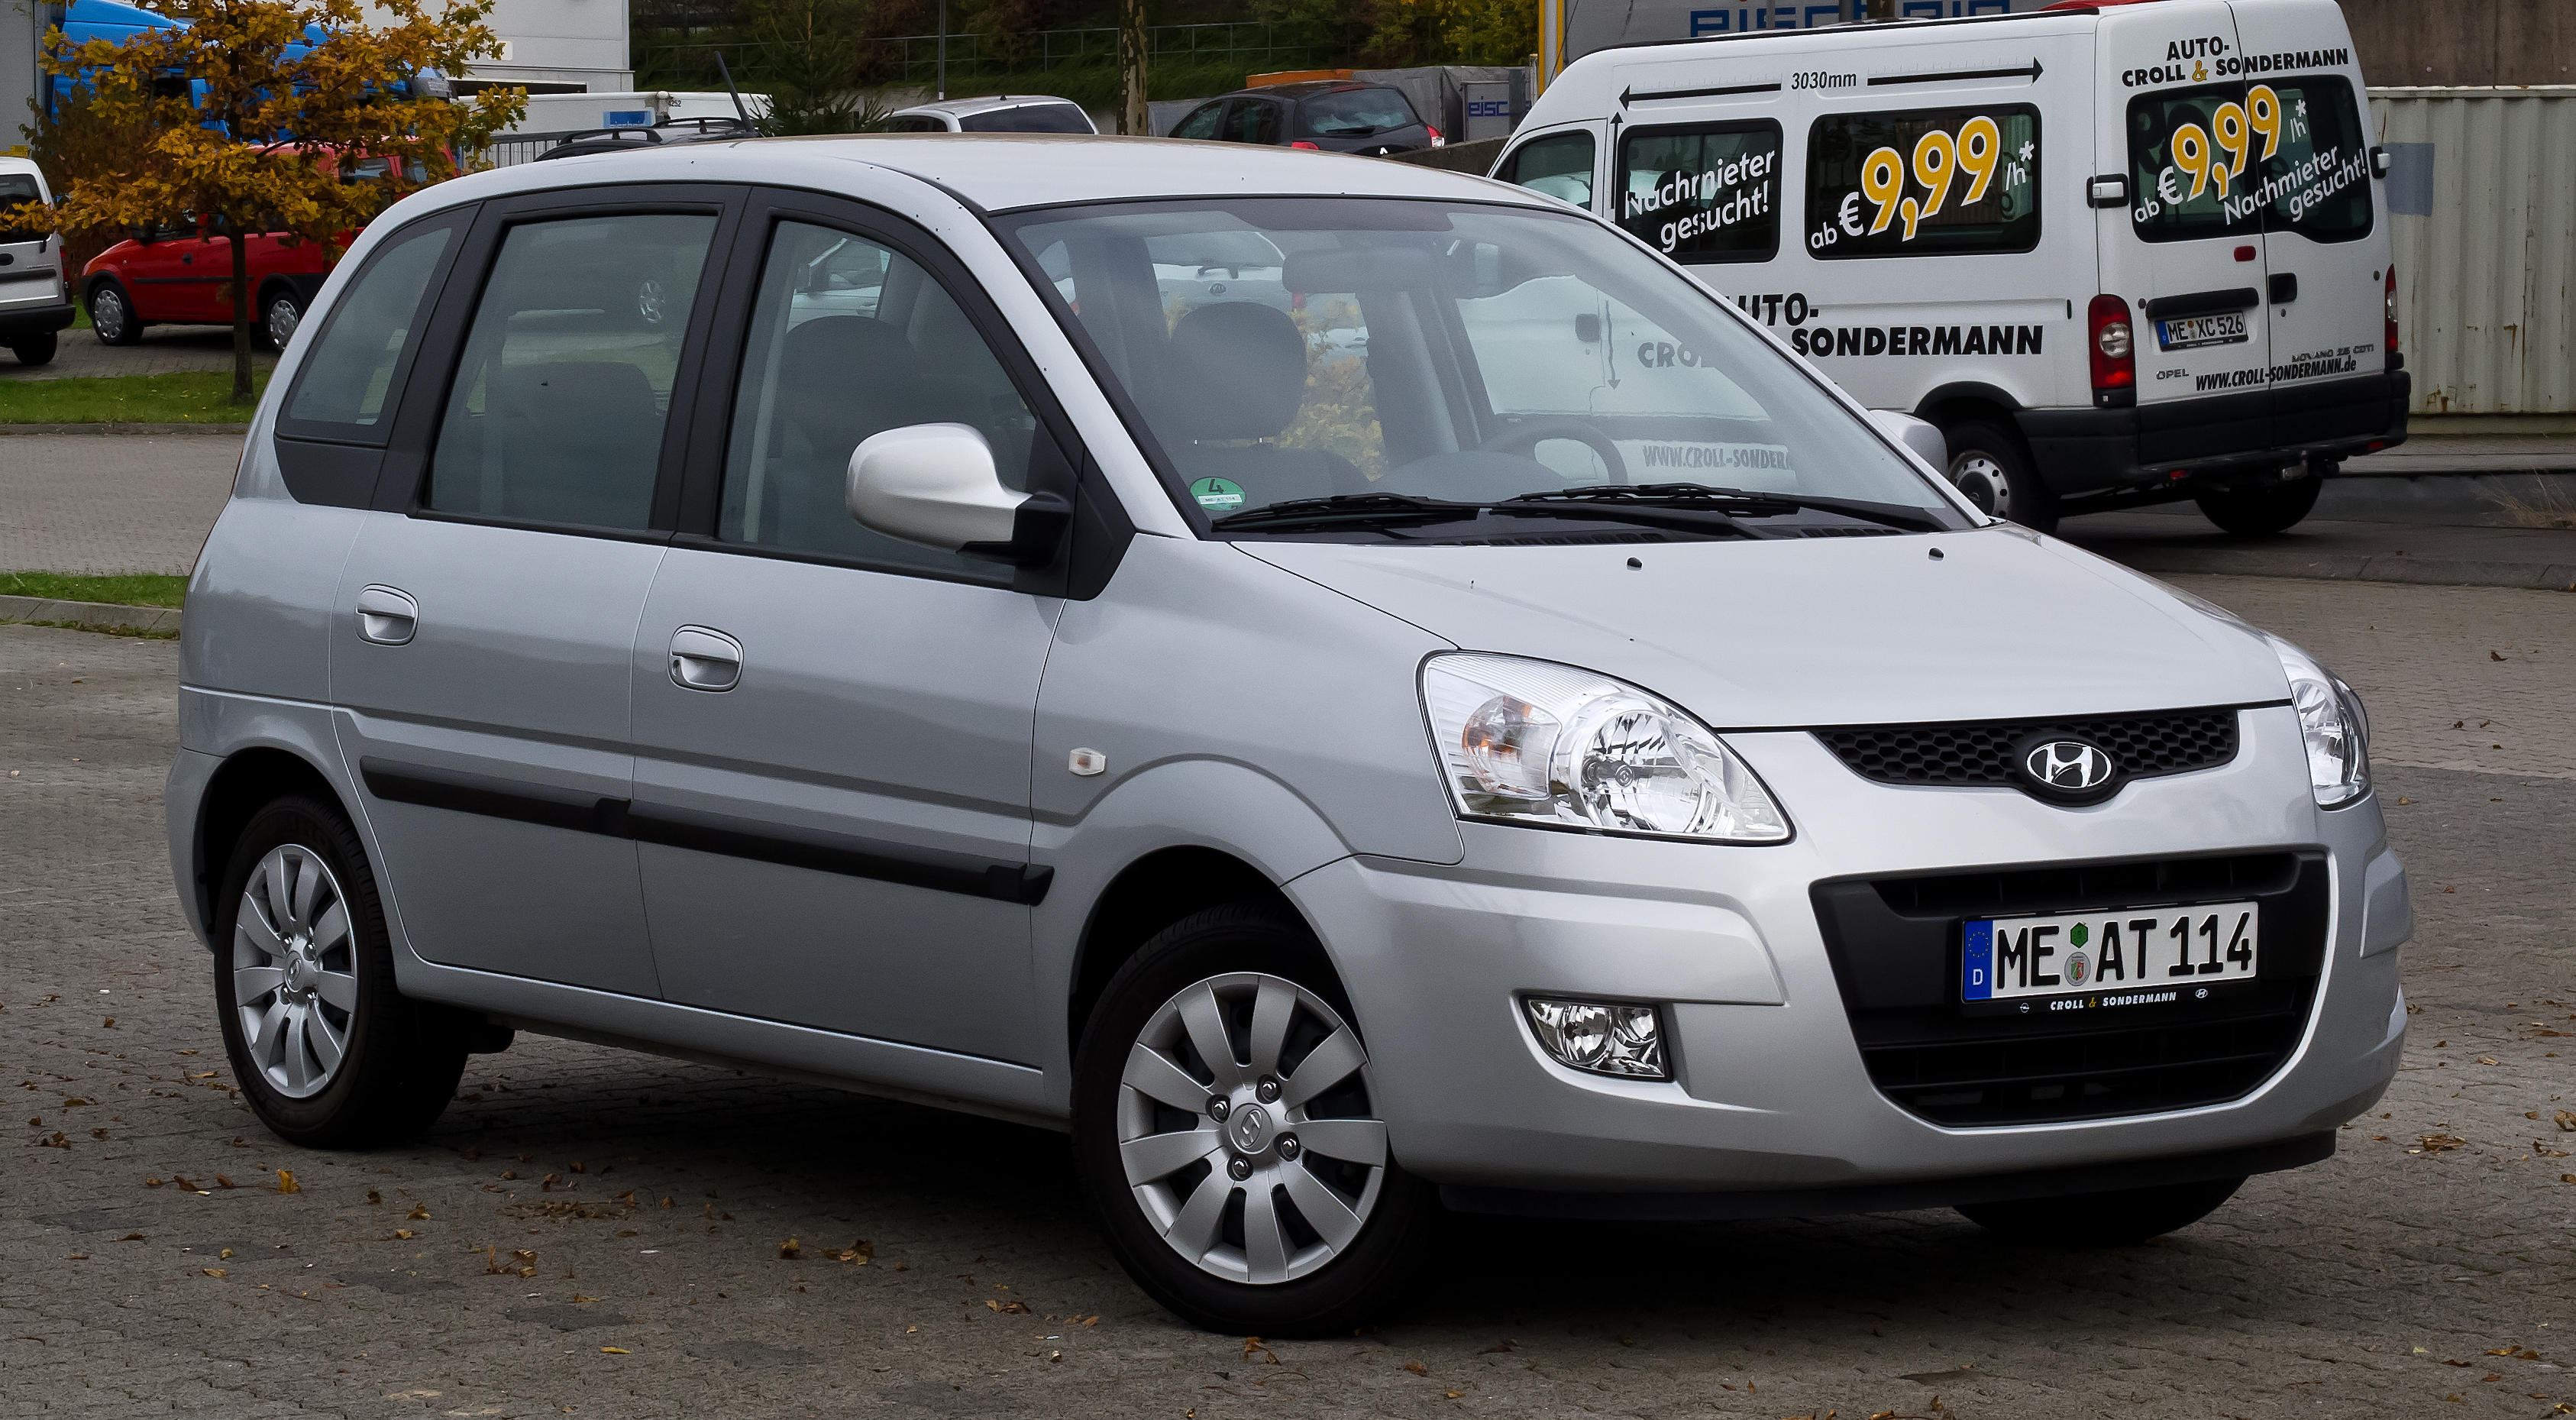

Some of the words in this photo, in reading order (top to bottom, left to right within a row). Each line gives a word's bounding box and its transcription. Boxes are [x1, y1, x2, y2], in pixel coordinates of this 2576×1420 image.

[2167, 36, 2230, 61] AUTO-
[1791, 71, 1857, 90] 3030mm
[2122, 64, 2186, 87] CROLL
[2192, 60, 2209, 82] &
[2216, 48, 2349, 76] SONDERMANN
[1624, 150, 1775, 219] Nachmieter
[2224, 146, 2338, 225] Nachmieter
[2290, 148, 2367, 222] gesucht!
[1660, 180, 1770, 253] gesucht!
[2135, 198, 2160, 222] ab
[1811, 222, 1837, 249] ab
[1725, 293, 1818, 327] UTO-
[1791, 325, 2044, 357] SONDERMANN
[2167, 322, 2188, 341] ME
[2196, 318, 2216, 338] XC
[2216, 315, 2244, 335] 526
[2156, 368, 2190, 380] OPEL
[2196, 356, 2357, 391] WWW.CROLL-SONDERMANN.de
[1208, 478, 1223, 493] 4
[1996, 925, 2060, 989] ME
[2095, 918, 2157, 982] AT
[2168, 911, 2252, 977] 114
[1973, 969, 1983, 985] D
[2050, 999, 2084, 1011] CROLL
[2088, 997, 2097, 1008] &
[2102, 991, 2177, 1007] SONDERMANN
